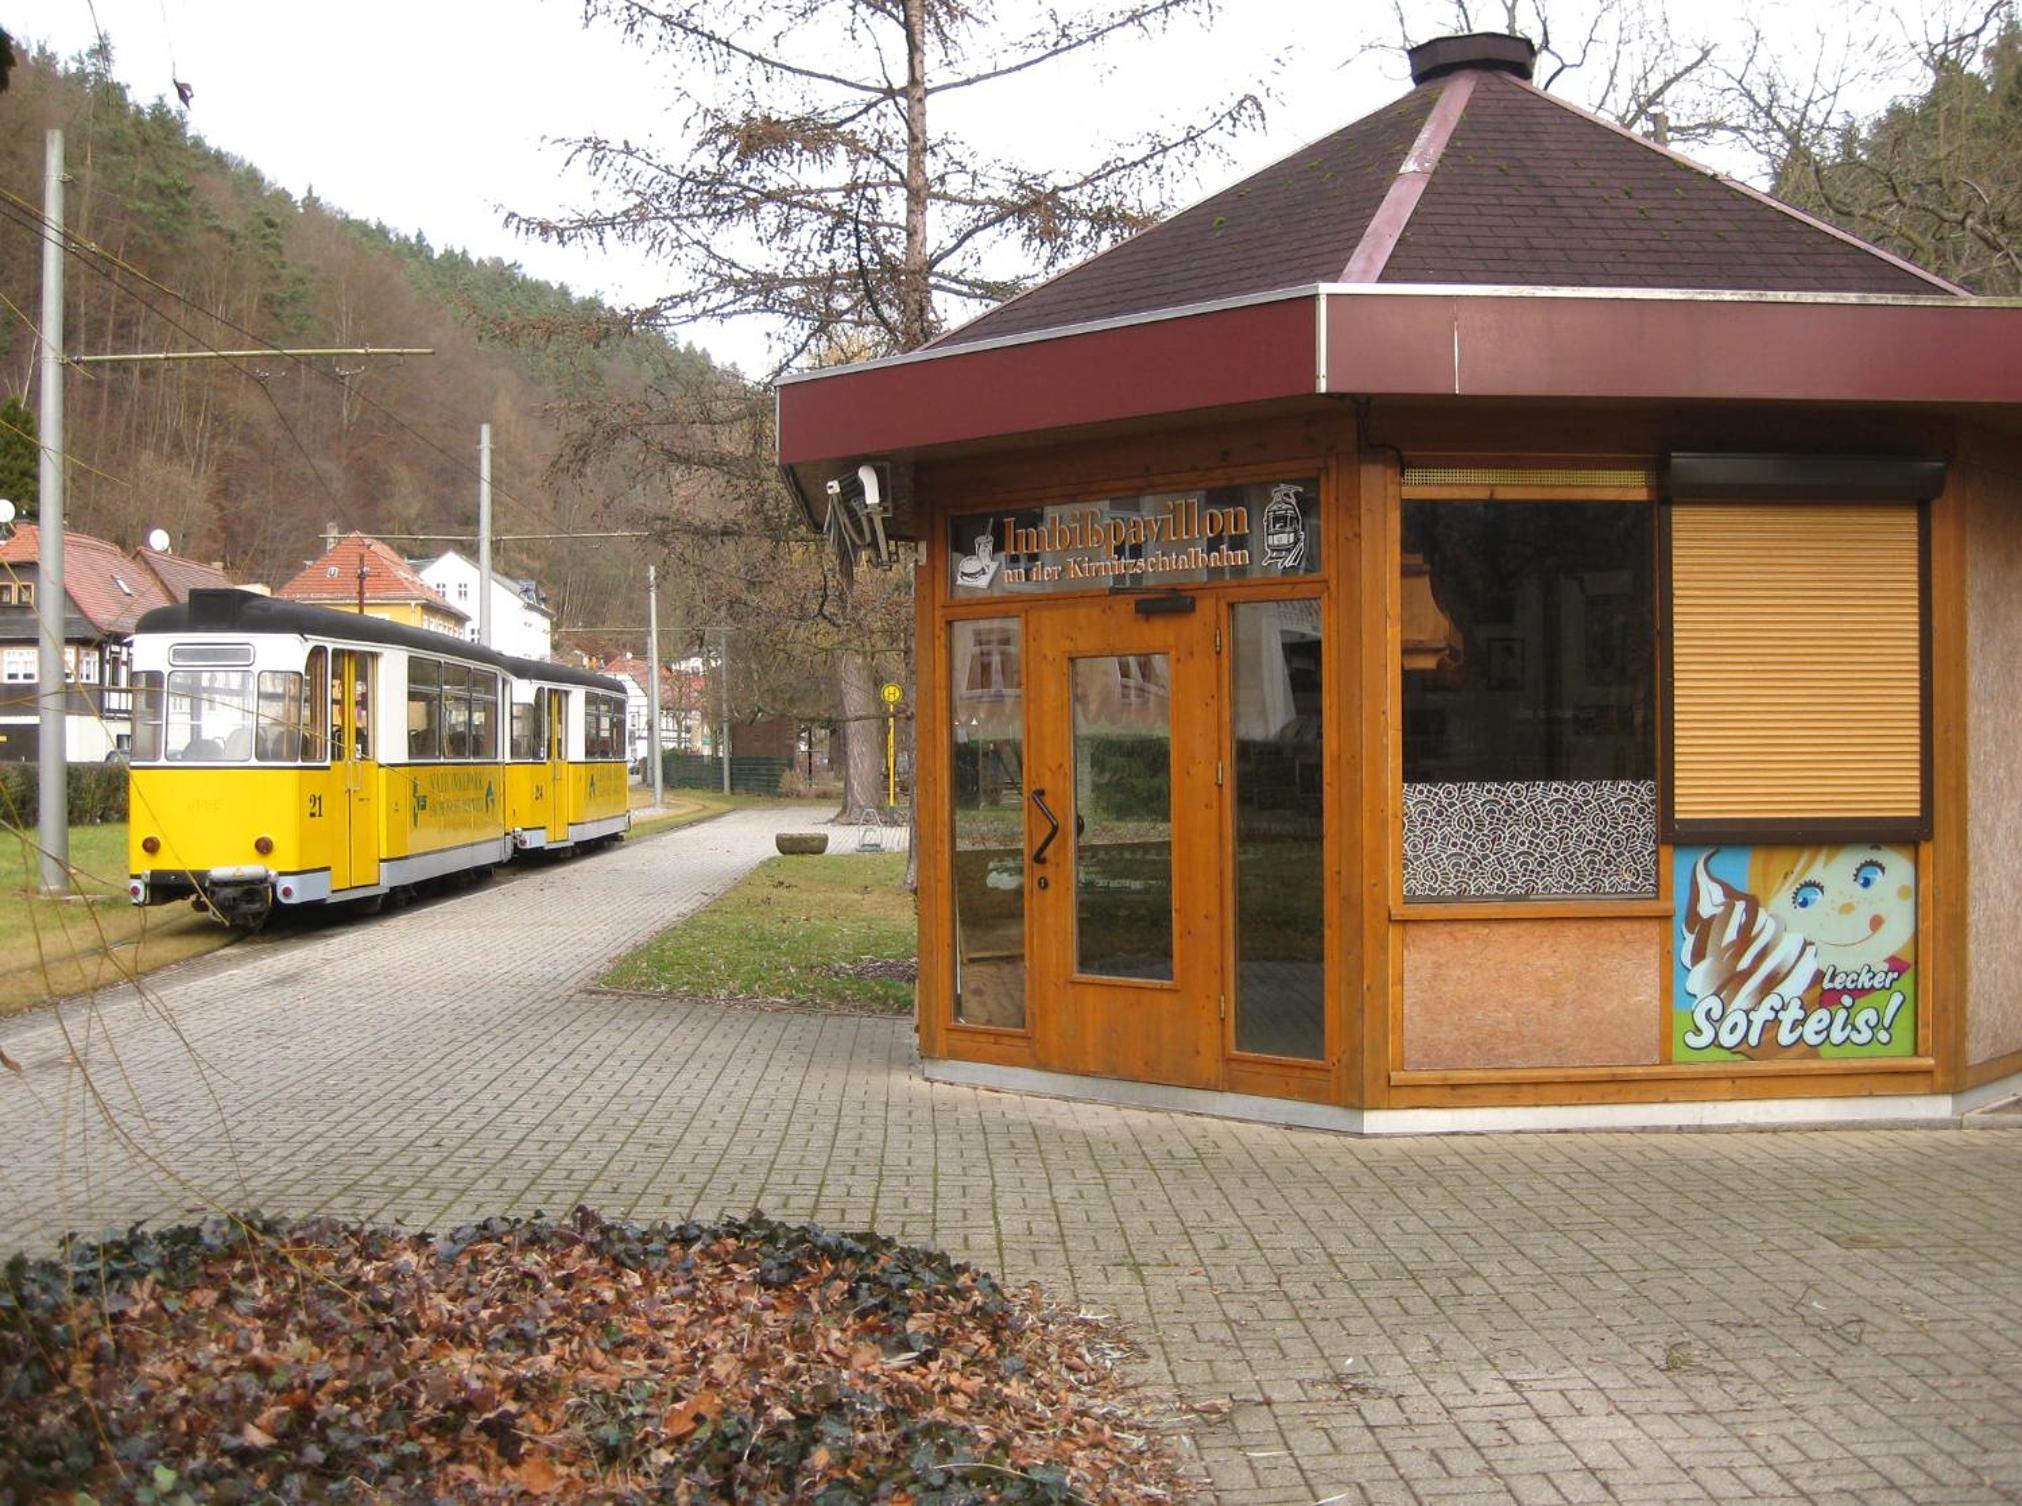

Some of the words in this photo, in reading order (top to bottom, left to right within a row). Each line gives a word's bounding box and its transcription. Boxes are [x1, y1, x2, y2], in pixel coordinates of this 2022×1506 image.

[1003, 498, 1249, 557] Imbißpavillon
[1002, 566, 1026, 584] an
[1030, 561, 1062, 582] der
[1067, 546, 1249, 579] Kirnitzschtalbahn
[308, 793, 323, 818] 21
[1822, 964, 1898, 990] Lecker
[1684, 992, 1905, 1049] Softeis!
